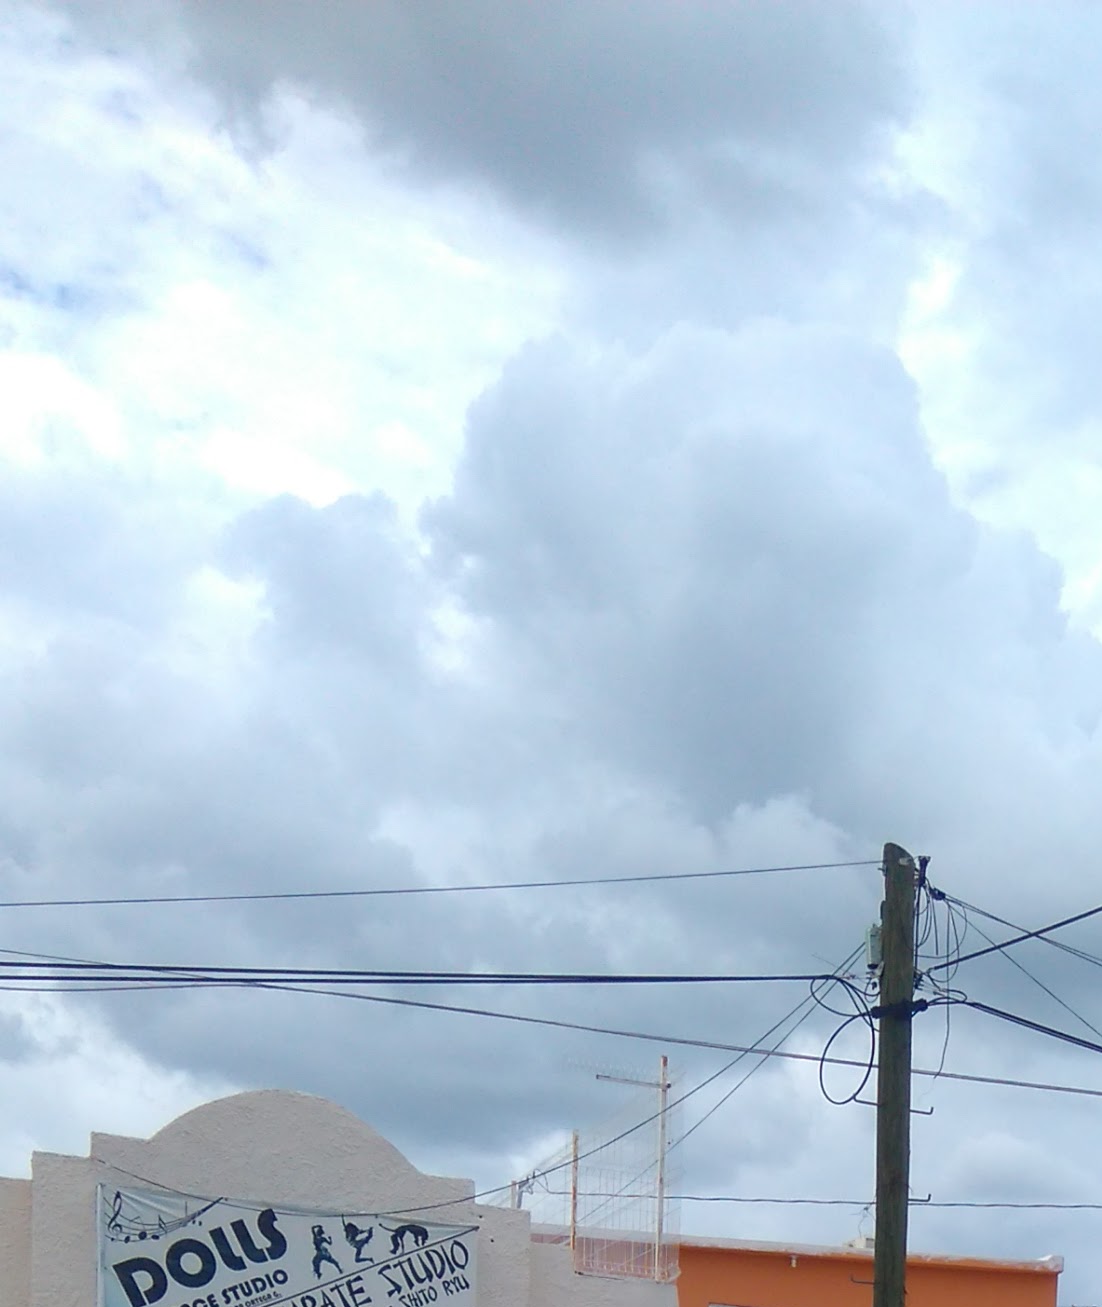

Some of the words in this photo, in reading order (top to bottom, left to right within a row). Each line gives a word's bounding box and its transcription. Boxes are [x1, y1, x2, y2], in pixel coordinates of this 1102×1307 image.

[378, 1239, 470, 1298] STUDIO
[221, 1269, 288, 1305] STUDIO
[442, 1274, 470, 1296] RYU
[245, 1294, 272, 1307] ORTEGA
